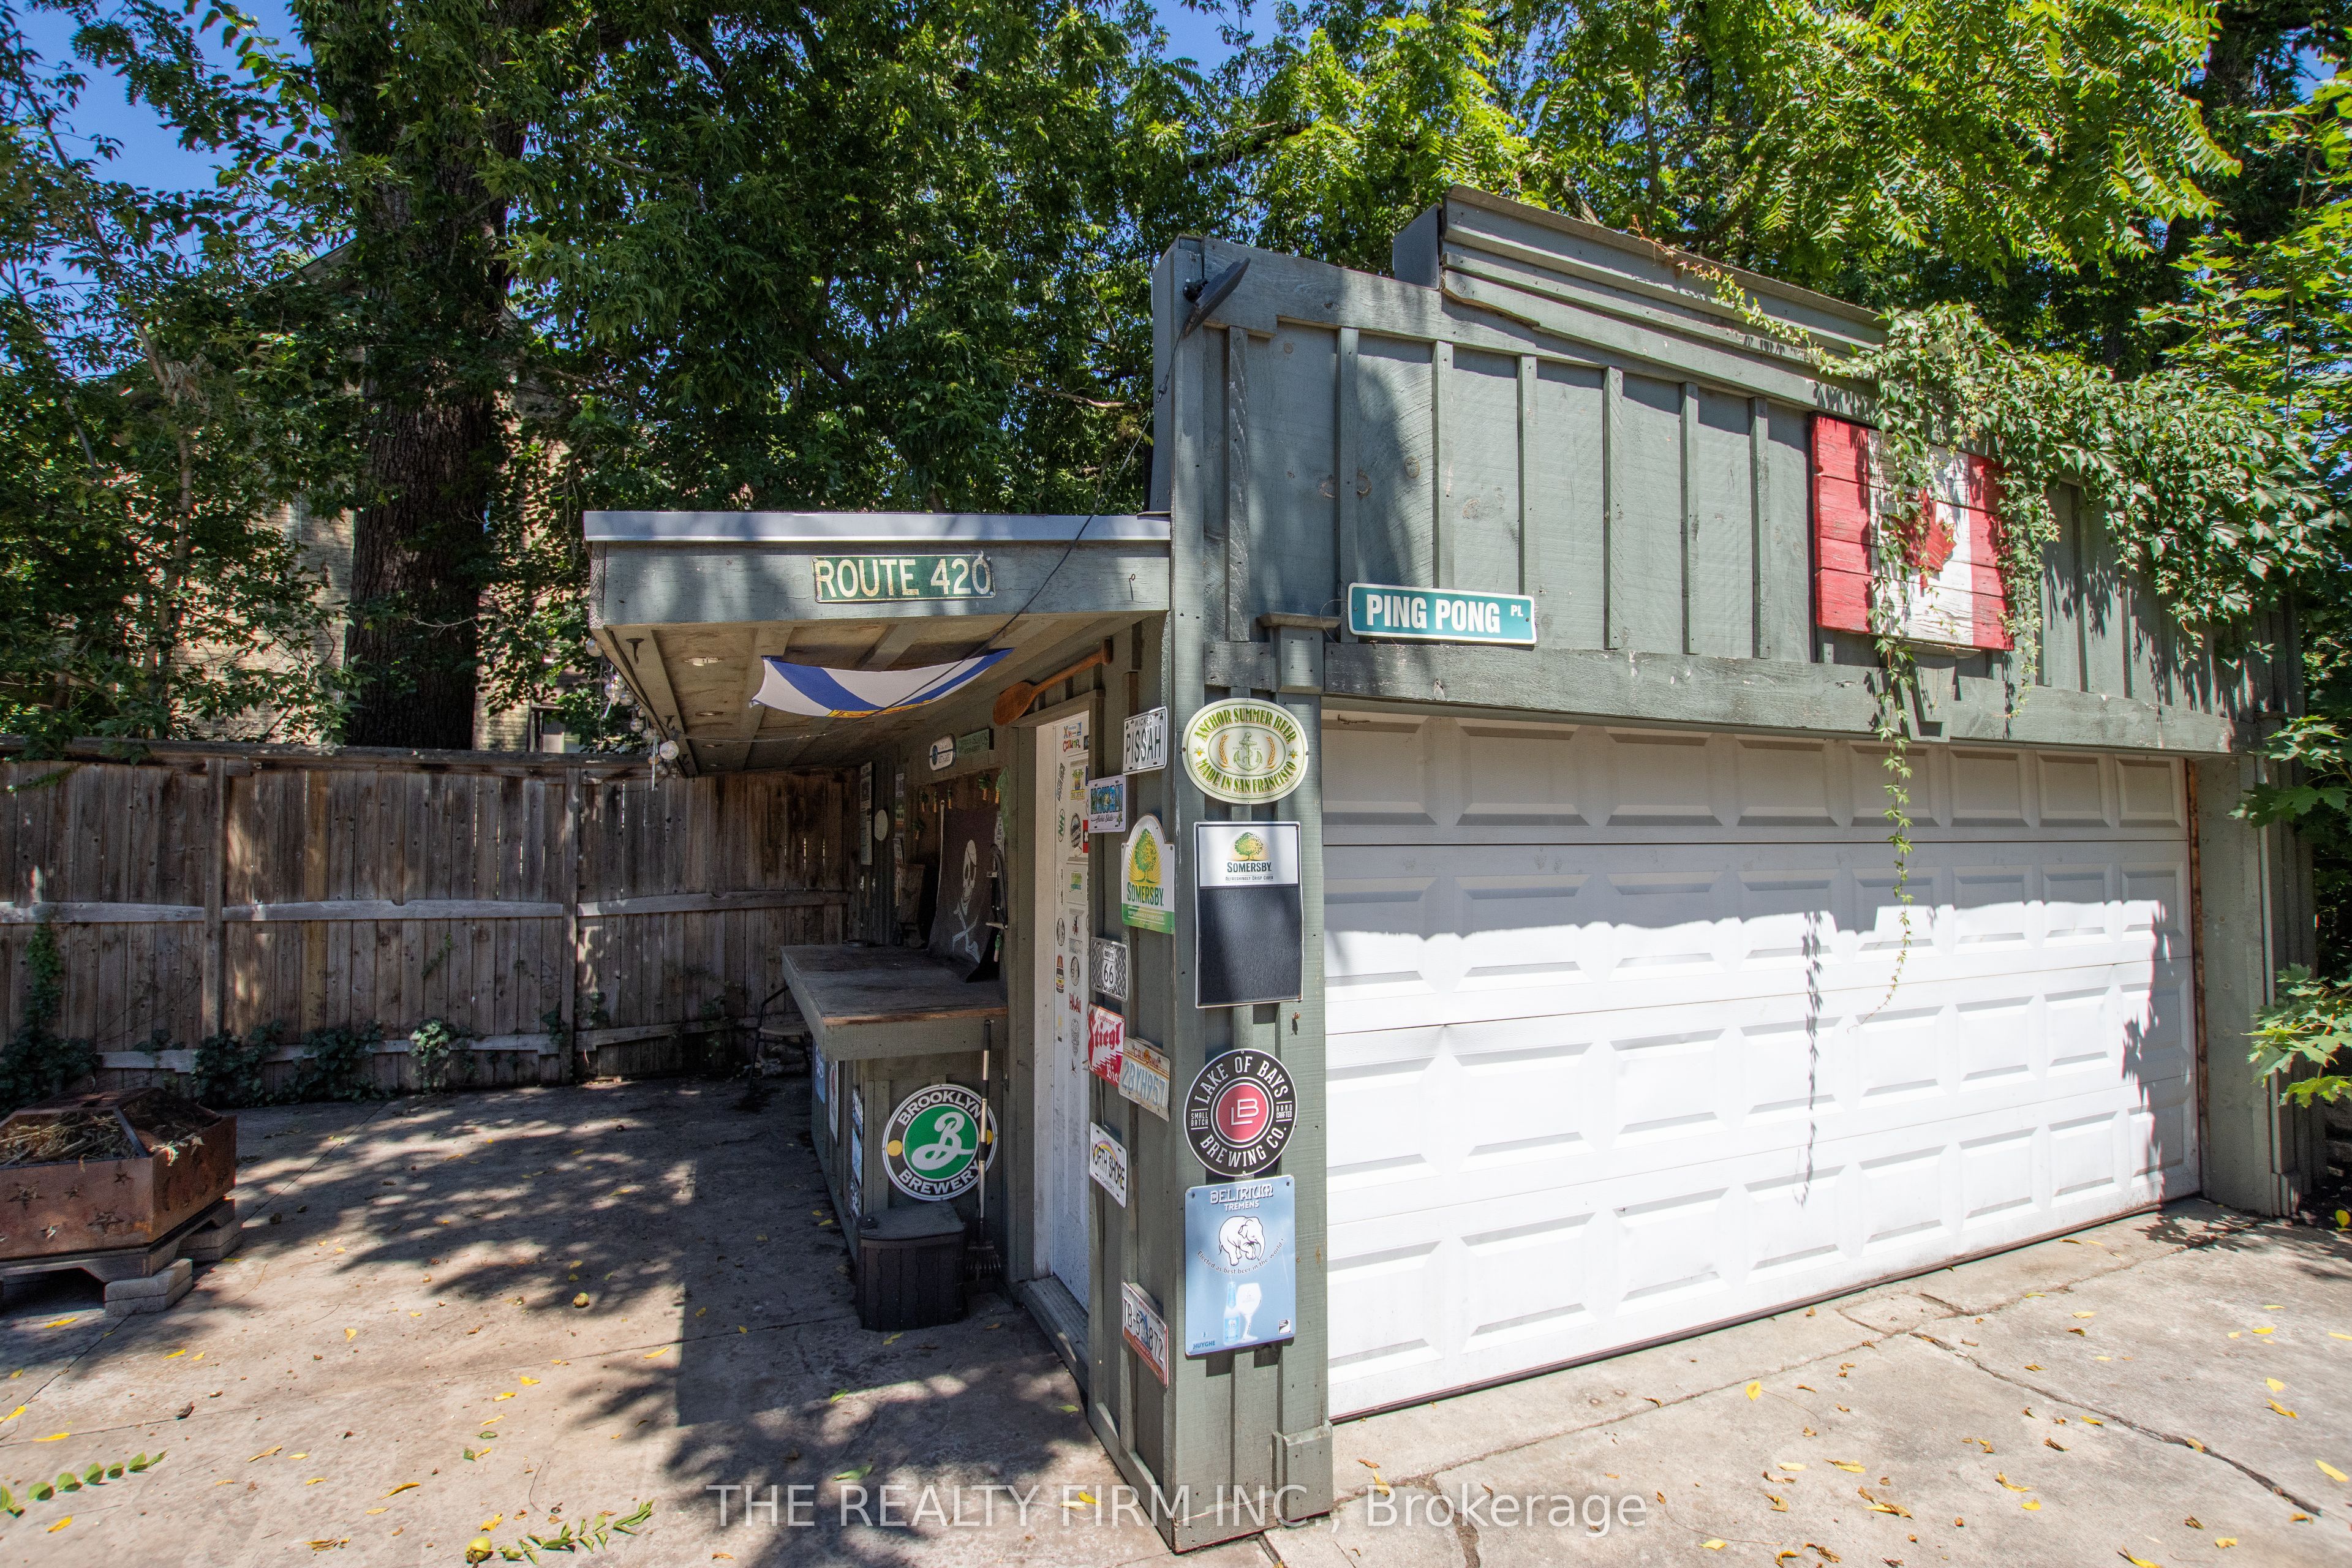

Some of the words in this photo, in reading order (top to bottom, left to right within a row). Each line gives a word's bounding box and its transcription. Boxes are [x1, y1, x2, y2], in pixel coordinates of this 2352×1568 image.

[815, 559, 919, 598] ROUTE
[930, 557, 992, 595] 420
[1366, 594, 1427, 629] PING
[1435, 598, 1501, 633] PONG
[1510, 605, 1524, 617] PL
[1134, 715, 1152, 727] WICKED
[1194, 709, 1233, 743] ANCHOR
[1233, 707, 1273, 726] SUMMER
[1272, 715, 1297, 744] BEER
[1196, 758, 1223, 787] MADE
[1220, 775, 1232, 791] IN
[1234, 778, 1251, 794] SAN
[1252, 761, 1297, 793] FRANCISCO
[1090, 783, 1123, 815] HAWAII
[1104, 950, 1114, 959] ROUTE
[1104, 963, 1114, 984] 66
[1088, 1008, 1122, 1069] Stiegl
[1107, 1063, 1119, 1084] Bie
[1134, 1048, 1159, 1070] CALIFORNIA
[1121, 1060, 1166, 1108] 2BYH957
[1194, 1063, 1229, 1104] LAKE
[1234, 1056, 1253, 1074] OF
[1257, 1060, 1289, 1098] BAYS
[897, 1090, 982, 1126] BROOKLYN
[1200, 1134, 1267, 1167] BREWING
[1267, 1126, 1287, 1148] CO.
[898, 1159, 979, 1194] BREWERY
[1091, 1140, 1107, 1174] NORTH
[1109, 1155, 1125, 1191] SHORE
[1210, 1183, 1273, 1205] DELIRIUM
[1224, 1200, 1260, 1212] TREMENS
[1197, 1250, 1215, 1268] Elected
[1269, 1242, 1283, 1259] world
[1139, 1300, 1150, 1314] MEXICO
[1193, 1340, 1216, 1349] HUYGHE
